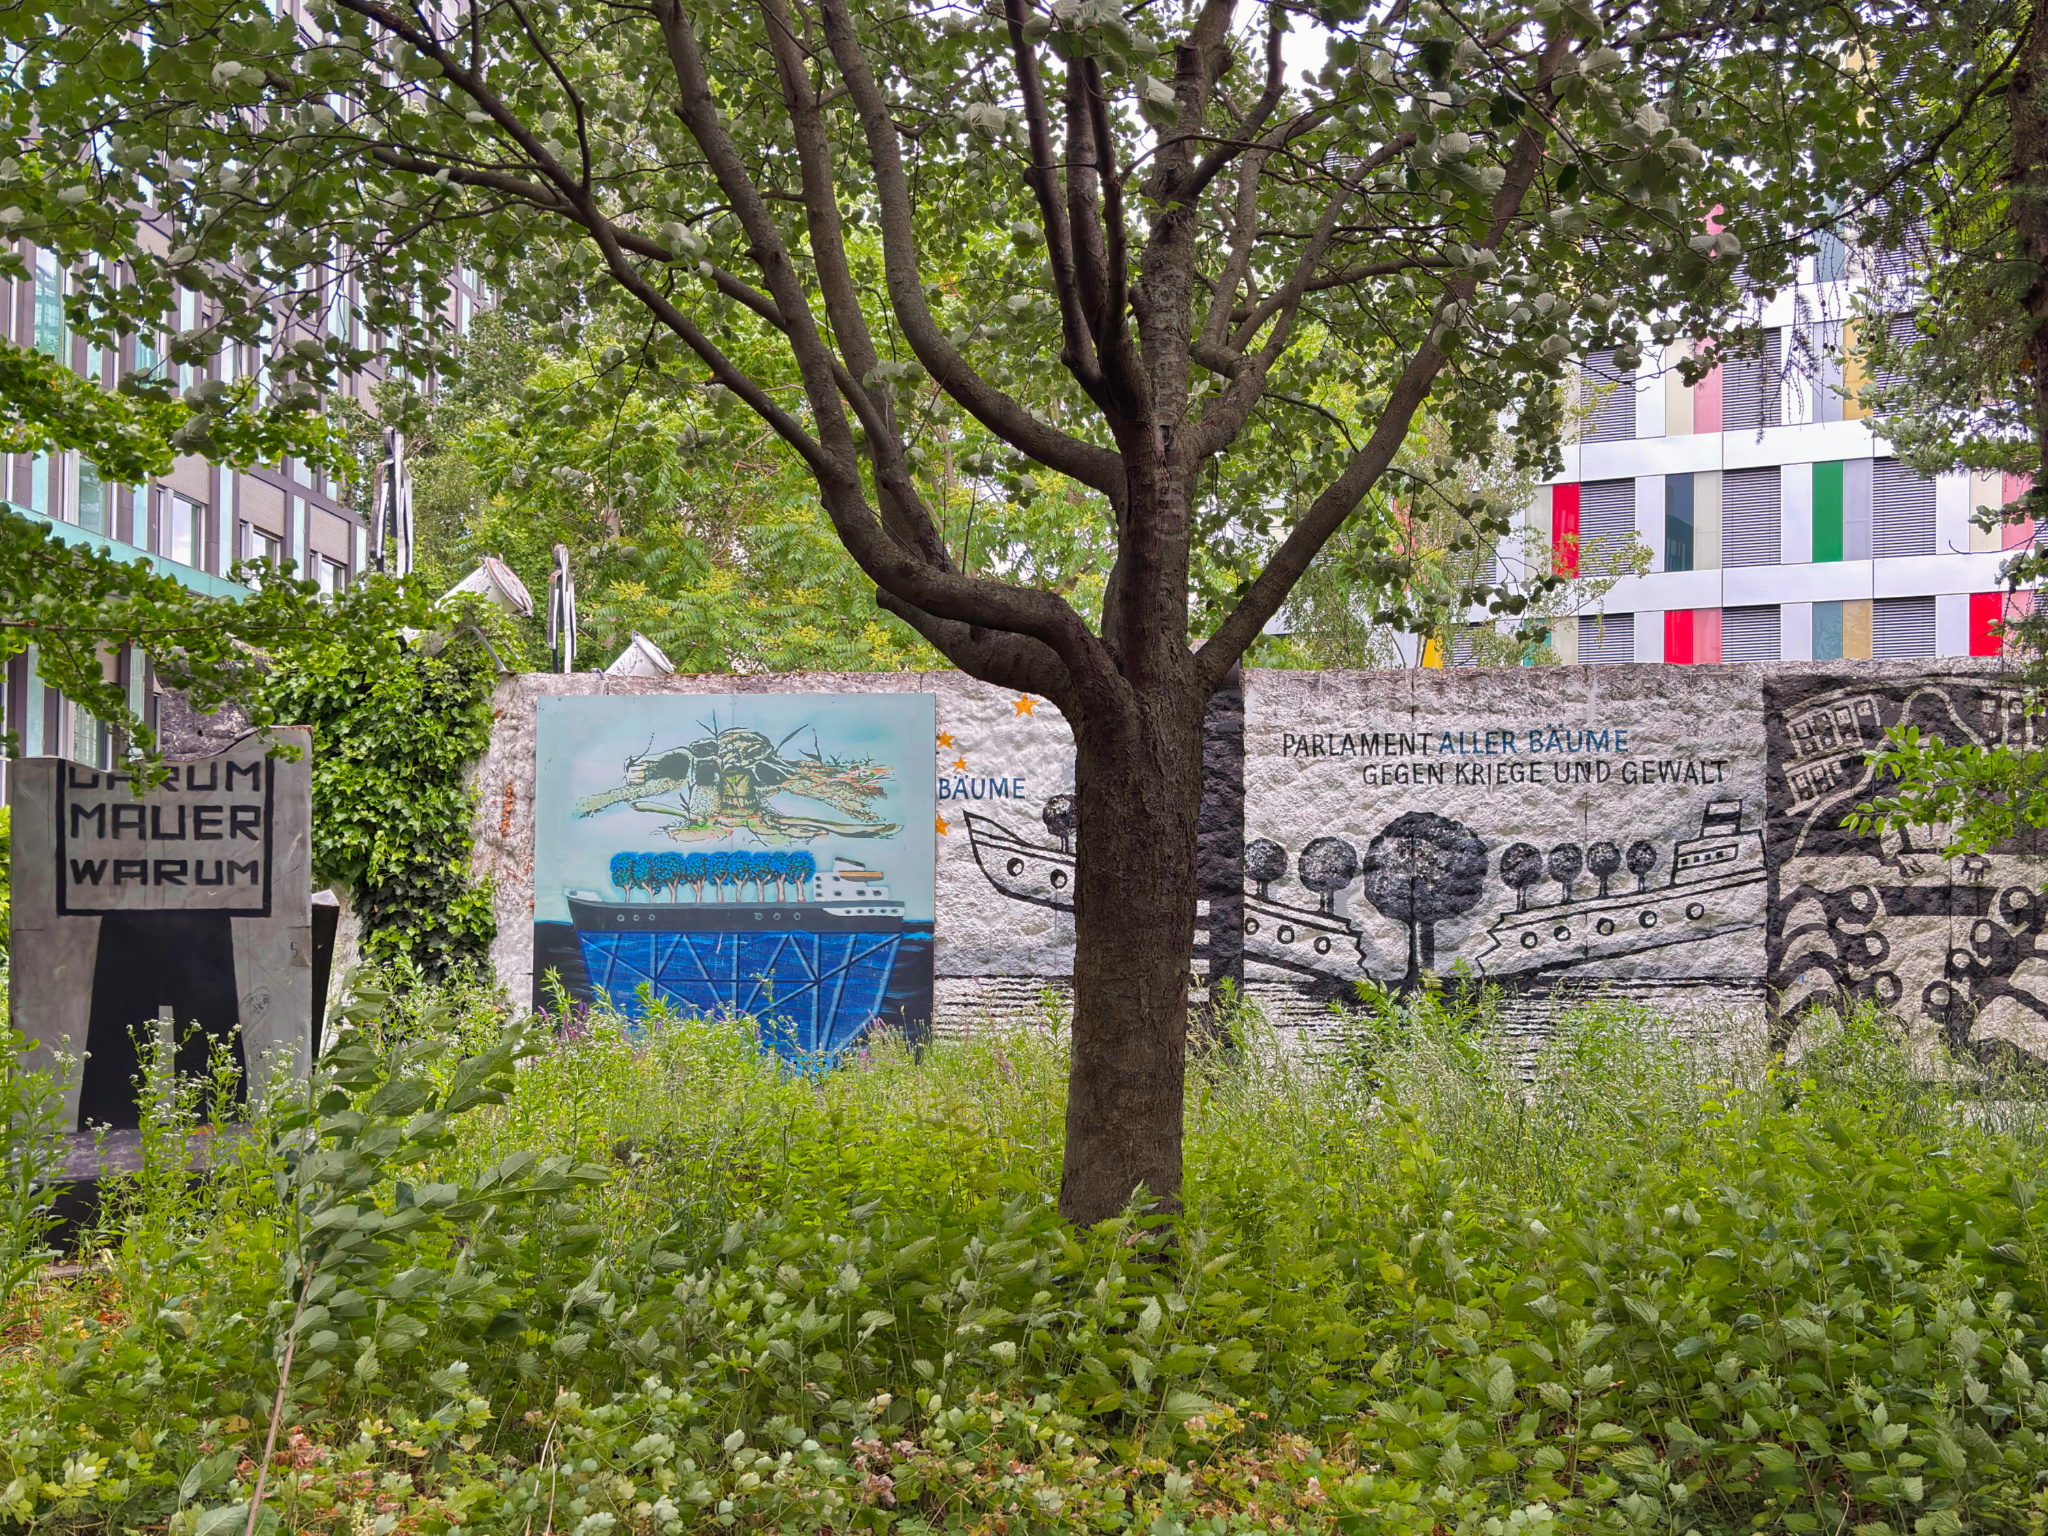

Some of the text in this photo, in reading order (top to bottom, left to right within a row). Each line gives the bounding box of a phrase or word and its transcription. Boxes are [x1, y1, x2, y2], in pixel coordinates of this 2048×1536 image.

[1283, 723, 1628, 757] PARLAMENT ALLER BÄUME
[1363, 760, 1728, 785] GEGEN KRIEGE UND GEWALT
[939, 774, 1026, 800] BÄUME
[71, 803, 261, 841] MAUER
[70, 858, 259, 886] WARUM
